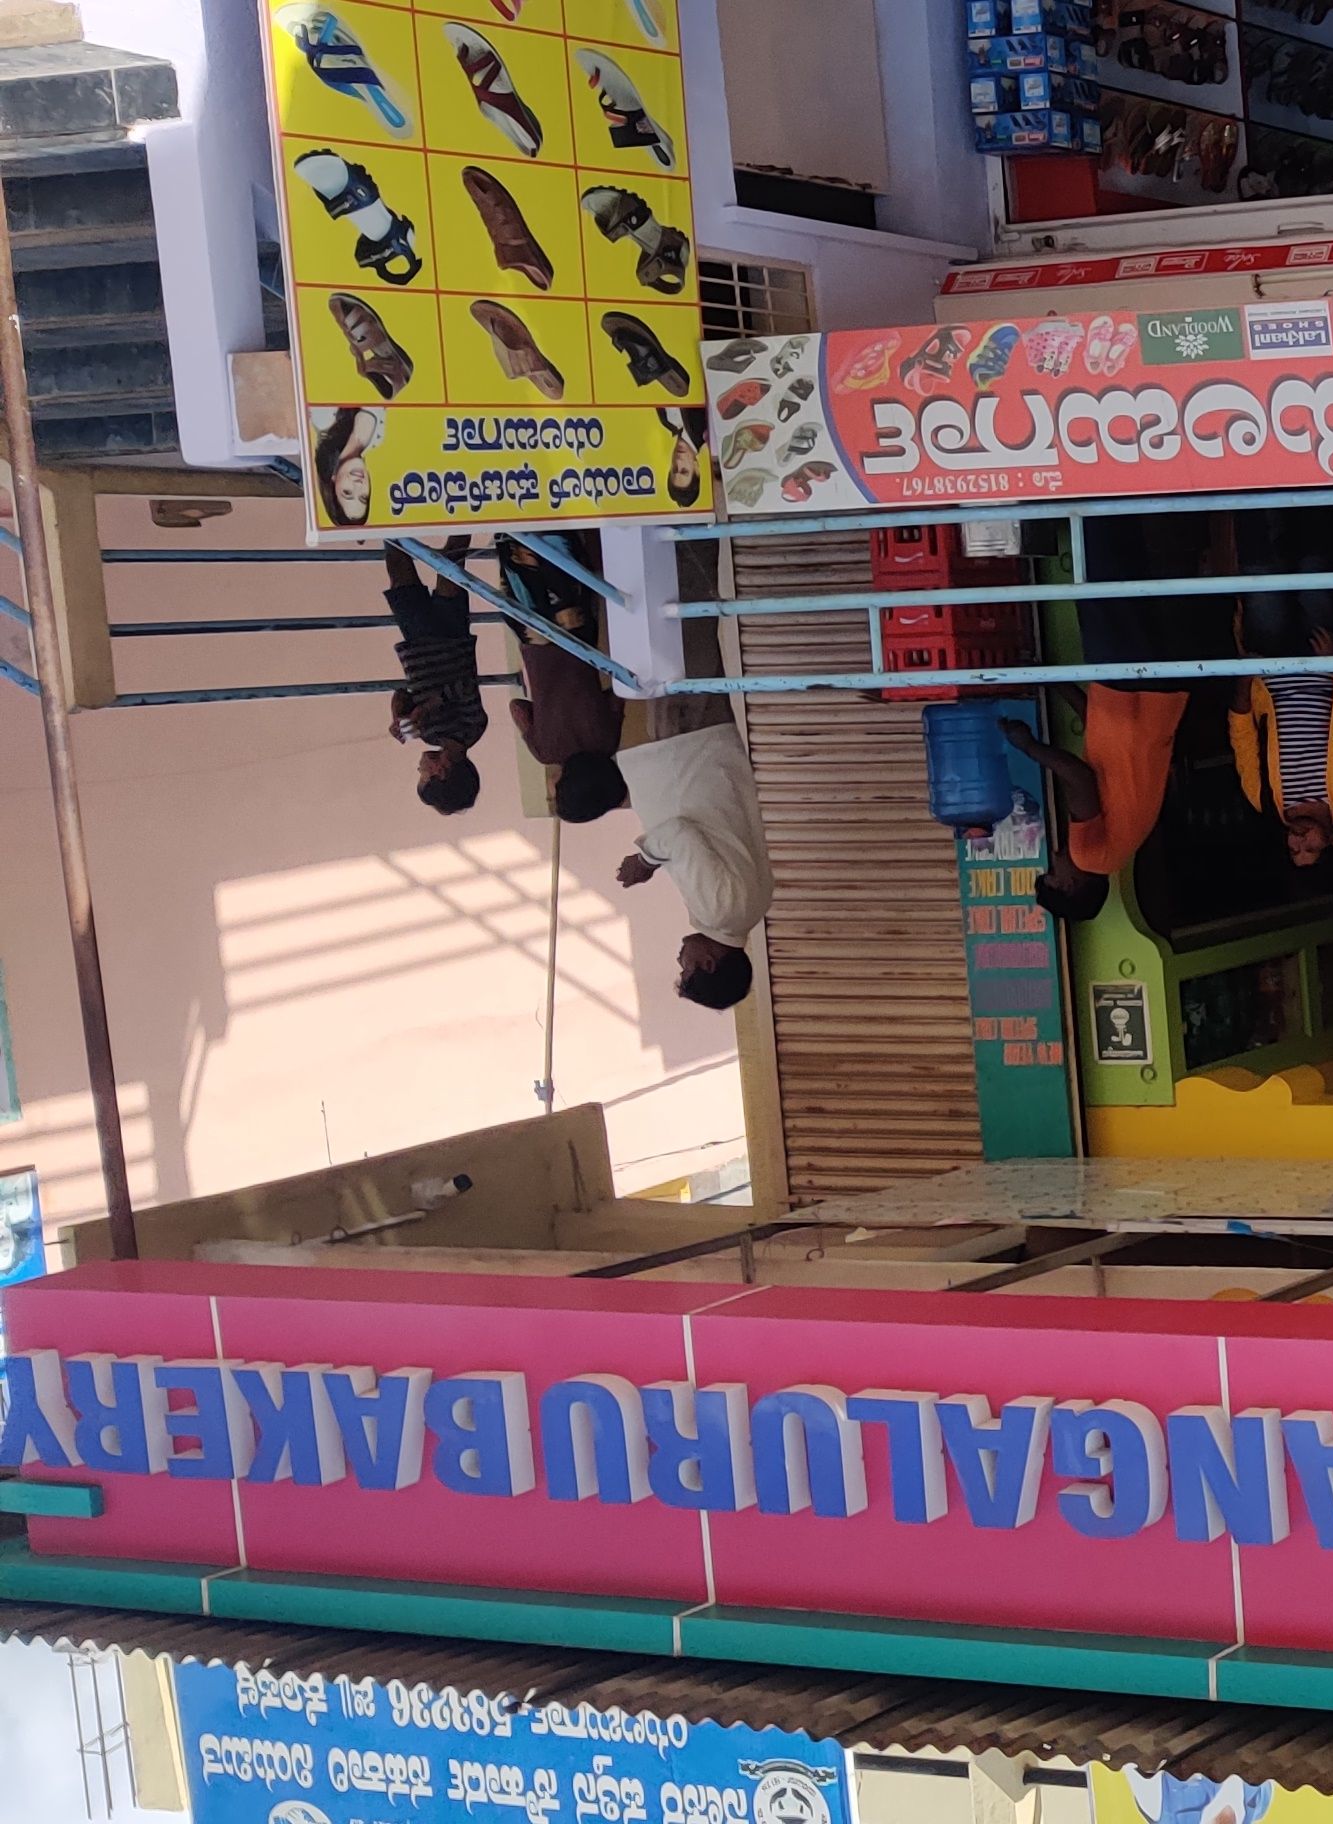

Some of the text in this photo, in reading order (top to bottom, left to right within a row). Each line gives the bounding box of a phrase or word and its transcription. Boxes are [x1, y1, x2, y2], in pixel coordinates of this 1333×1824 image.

[1148, 313, 1234, 338] WOODLAND
[1253, 329, 1327, 347] Lakhani
[441, 417, 603, 460] ಯಲಬುರ್ಗಾ
[548, 466, 656, 509] ರಾಯಲ್
[0, 1348, 531, 1498] BAKERY
[200, 1733, 314, 1792] ನಿಯಮಿತ
[328, 1747, 432, 1809] ಸಹಕಾರಿ
